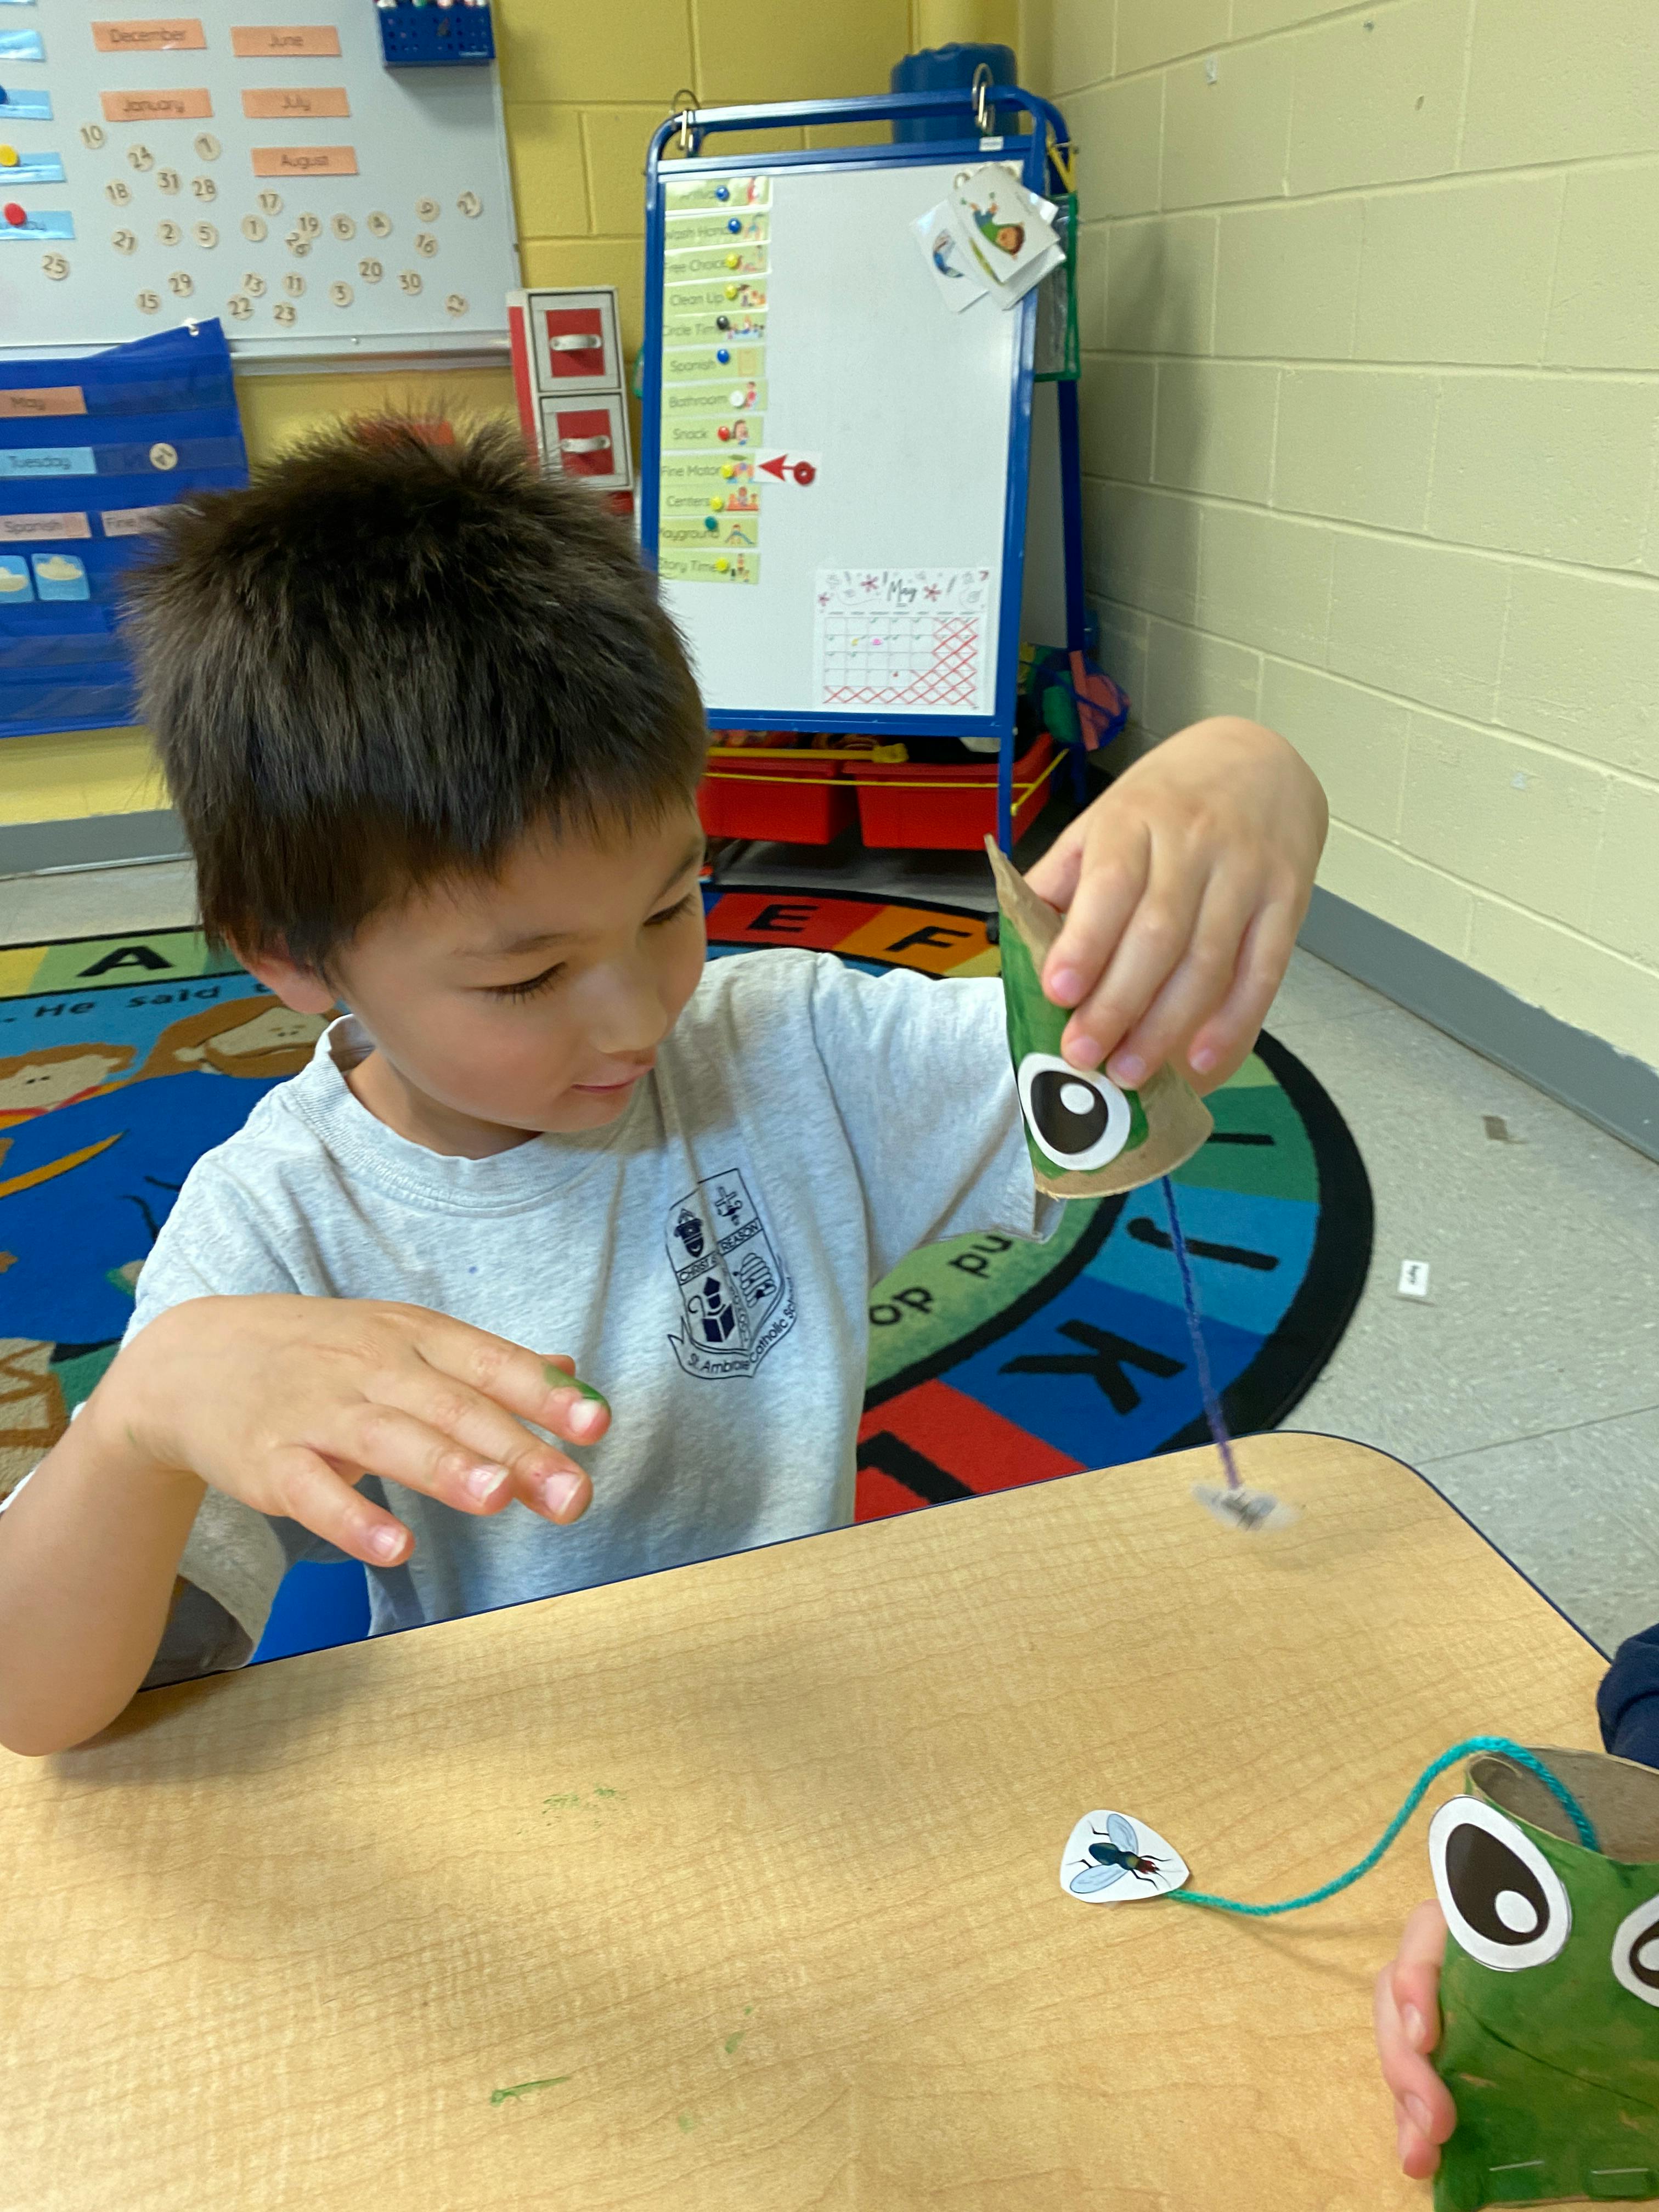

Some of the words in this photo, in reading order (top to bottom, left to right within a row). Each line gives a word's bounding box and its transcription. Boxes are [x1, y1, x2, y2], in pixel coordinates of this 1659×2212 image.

[110, 29, 186, 43] December
[268, 33, 304, 47] June
[123, 100, 185, 114] January
[281, 94, 312, 111] July
[81, 125, 104, 143] 10
[281, 154, 329, 170] August
[159, 172, 179, 189] 31
[192, 179, 216, 196] 28
[106, 183, 129, 199] 18
[258, 194, 279, 208] 17
[162, 224, 174, 239] 2
[300, 217, 318, 232] 19
[337, 218, 349, 234] 6
[698, 224, 731, 237] Hand
[199, 226, 211, 241] 5
[417, 235, 435, 253] 16
[43, 255, 67, 274] 25
[360, 261, 382, 276] 20
[690, 258, 728, 273] Choic
[168, 274, 191, 292] 29
[287, 275, 302, 291] 11
[399, 273, 421, 290] 30
[335, 285, 346, 300] 3
[669, 294, 704, 307] Clean
[706, 291, 725, 304] Up
[139, 294, 158, 309] 15
[227, 297, 255, 315] 22
[274, 304, 296, 320] 23
[695, 323, 717, 335] Tim
[670, 359, 716, 373] Spanish
[11, 397, 46, 411] May
[669, 395, 728, 408] Bathroom
[673, 428, 707, 439] Snack
[8, 455, 71, 470] Tuesday
[662, 465, 684, 476] Fine
[687, 464, 722, 476] Motor
[666, 495, 712, 507] Centers
[4, 521, 63, 535] Spanish
[887, 579, 917, 603] May
[746, 904, 819, 933] E
[885, 926, 973, 952] F
[76, 945, 174, 978] A
[34, 1001, 96, 1018] He
[126, 986, 220, 1008] said
[721, 1221, 759, 1251] REASON
[749, 1318, 788, 1363] Catholic
[997, 1318, 1187, 1415] K
